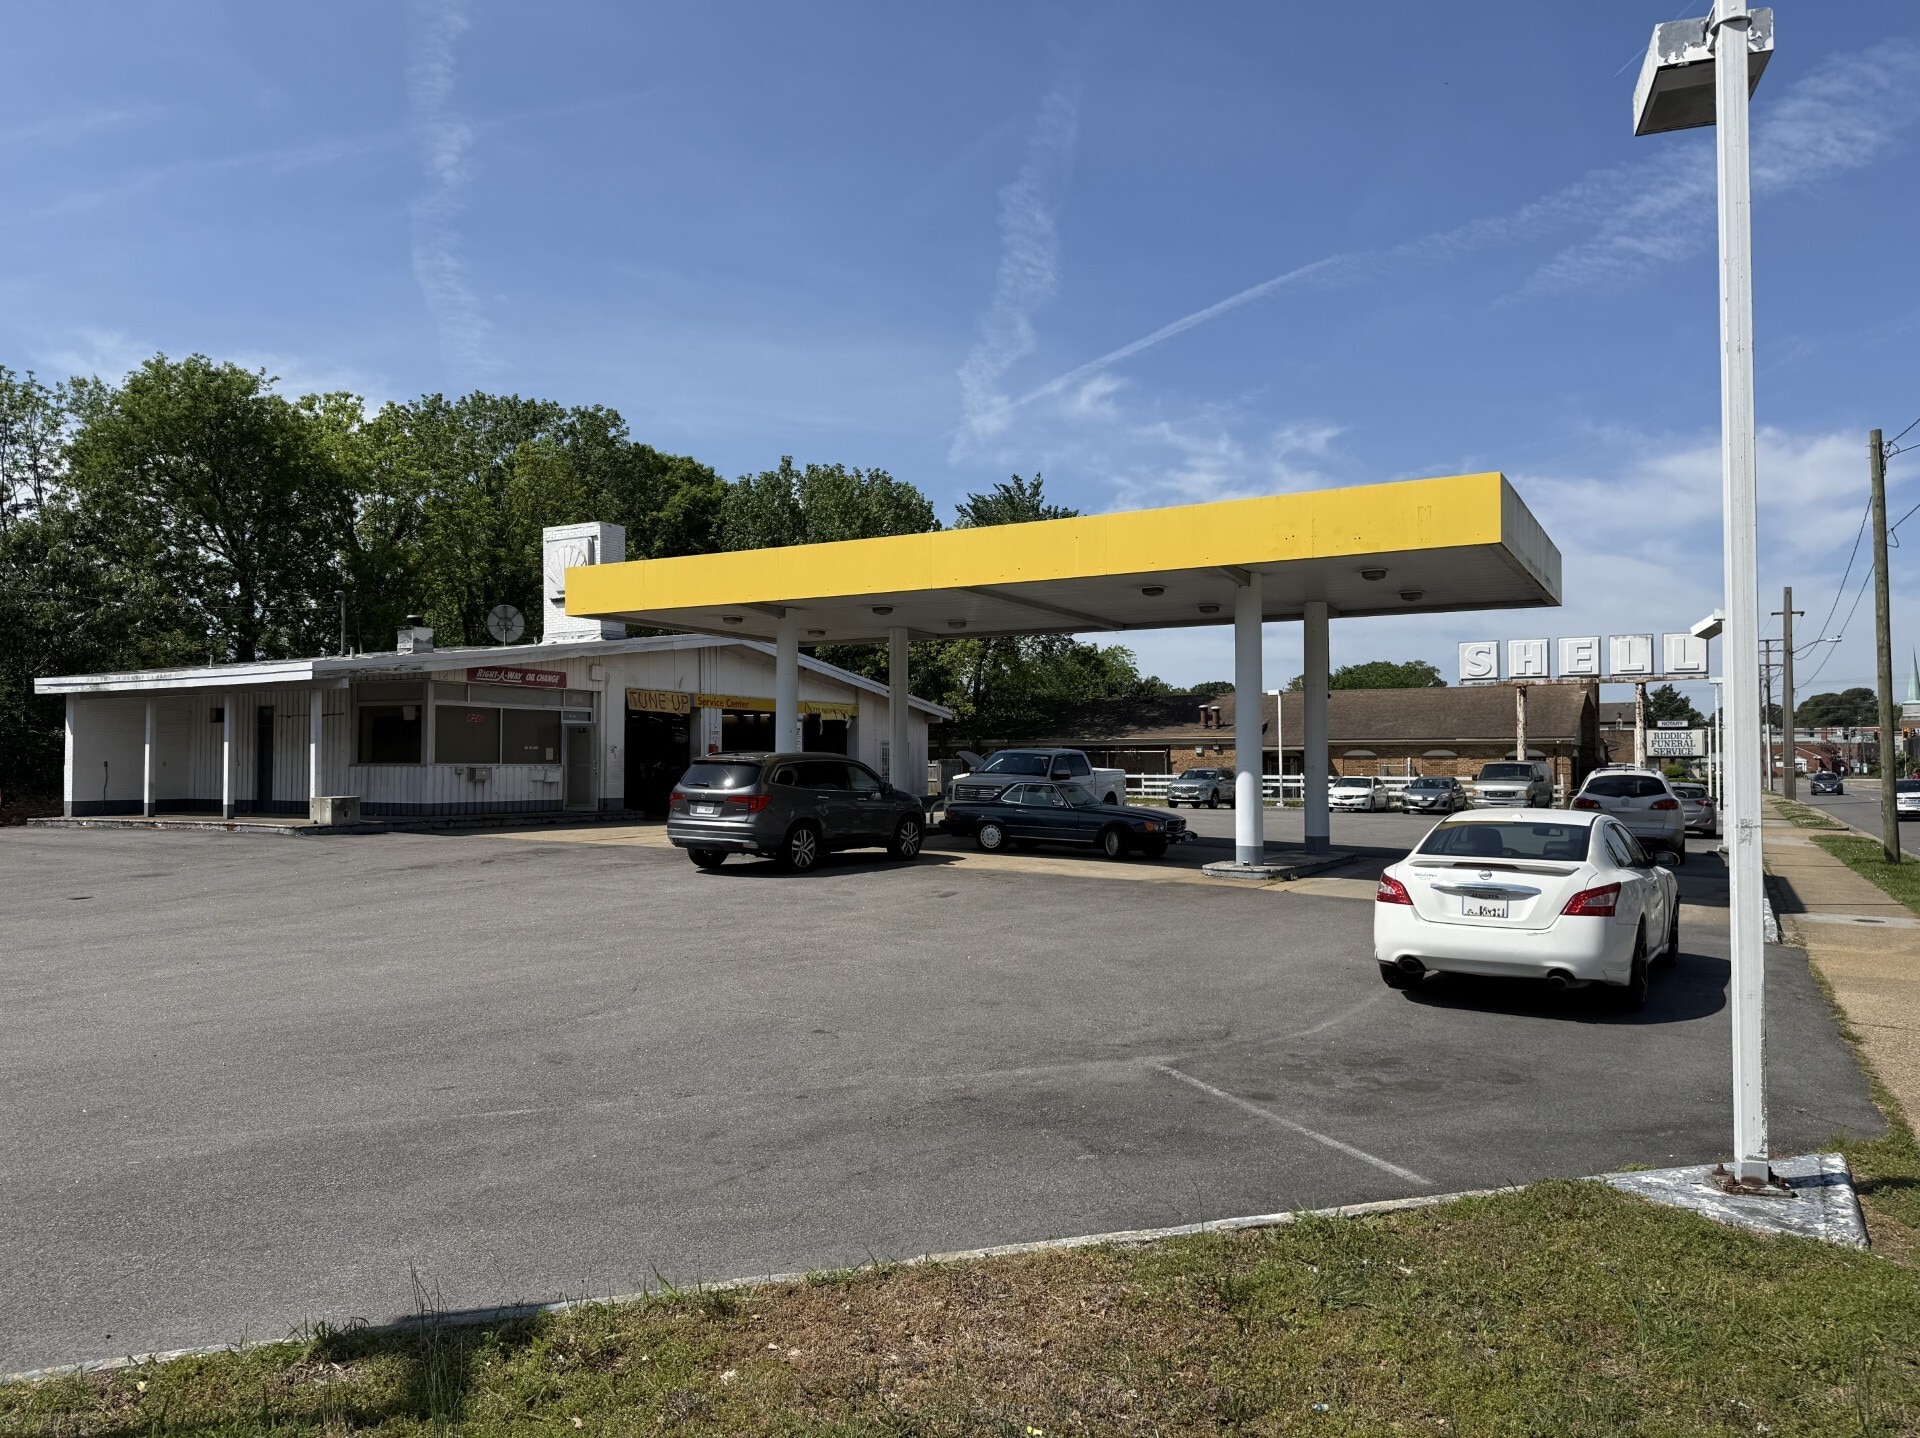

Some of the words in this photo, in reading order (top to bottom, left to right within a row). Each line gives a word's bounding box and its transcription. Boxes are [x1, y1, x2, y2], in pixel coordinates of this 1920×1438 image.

[1465, 637, 1699, 676] SHELL
[526, 673, 535, 681] OIL
[537, 674, 559, 683] CHANGE
[628, 691, 667, 710] TUNE
[671, 694, 689, 712] UP
[697, 696, 724, 708] Service
[726, 700, 750, 708] Center
[1653, 732, 1692, 740] RIDDICK
